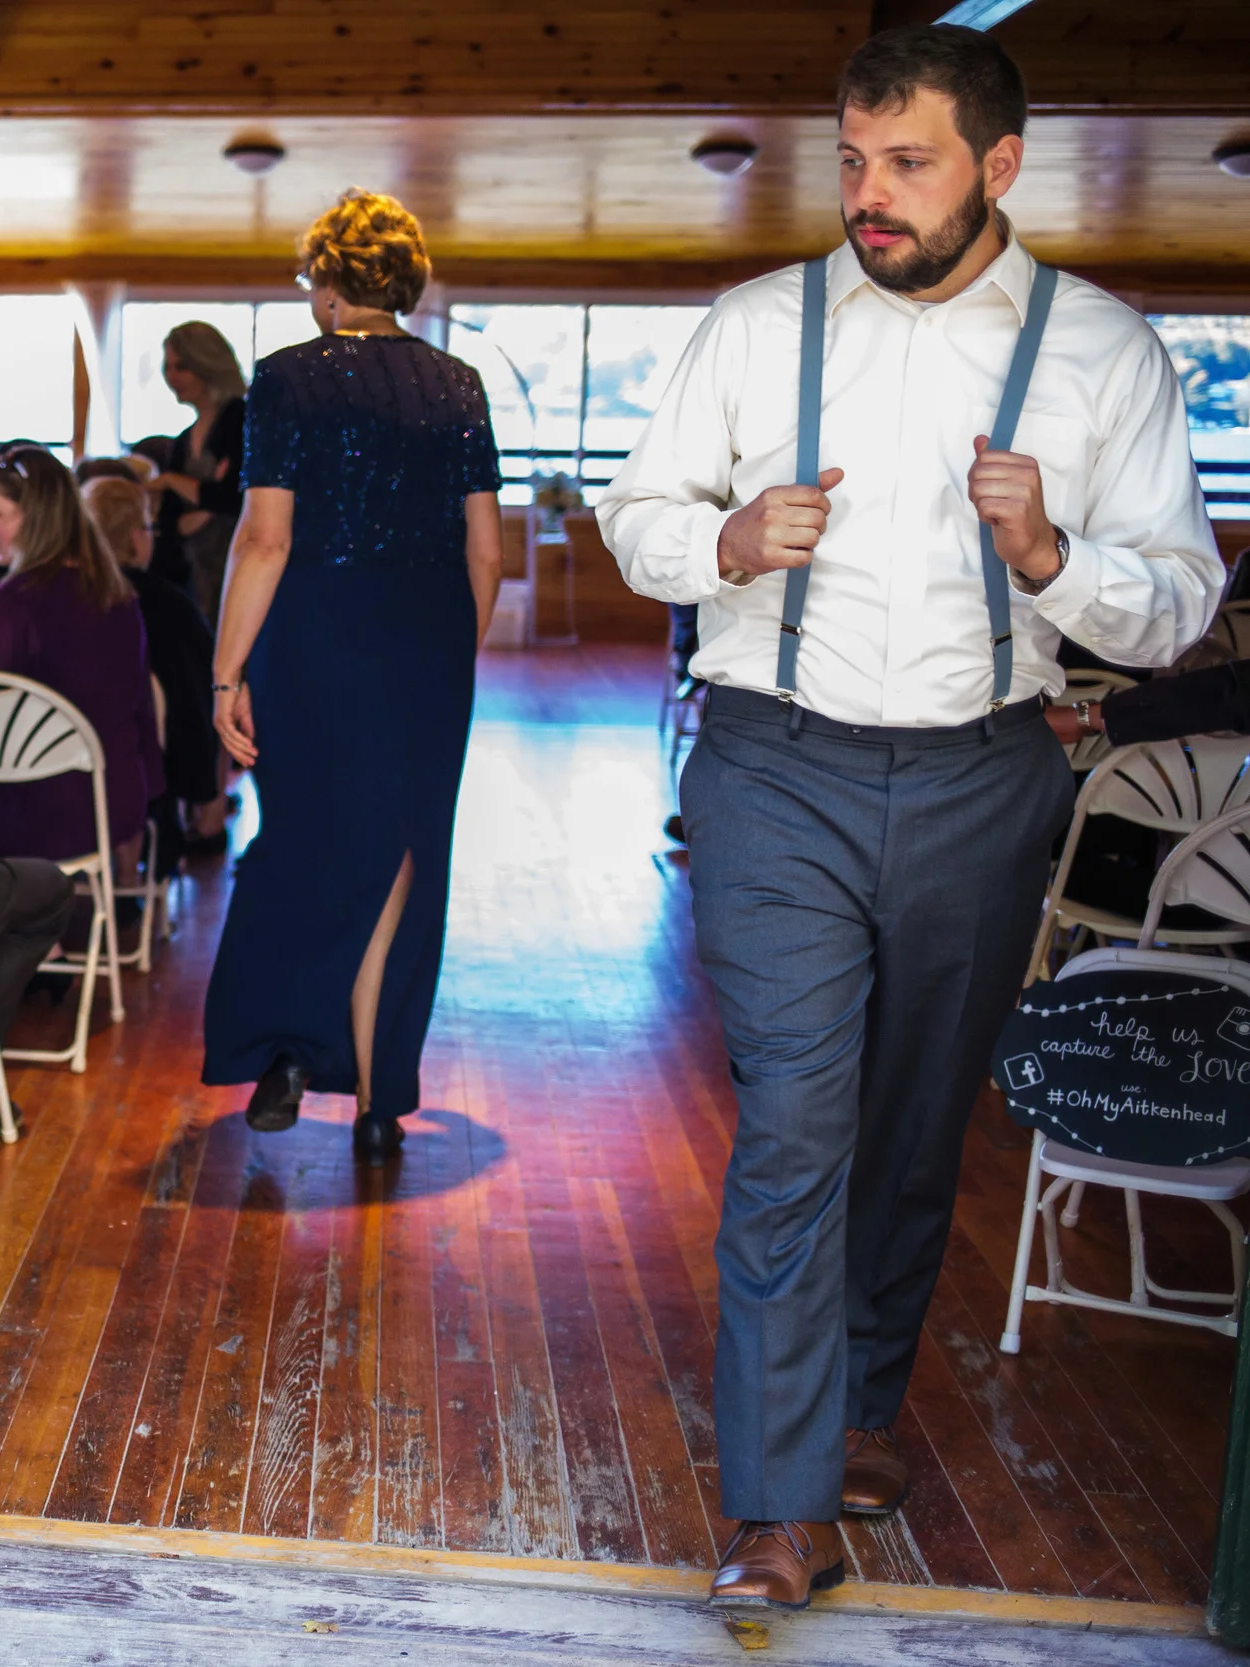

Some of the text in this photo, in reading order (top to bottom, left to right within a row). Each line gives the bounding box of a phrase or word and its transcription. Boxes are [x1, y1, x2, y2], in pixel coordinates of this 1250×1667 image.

[1090, 1010, 1205, 1052] help us
[1040, 1038, 1116, 1061] capture
[1131, 1045, 1172, 1067] the
[1047, 1087, 1227, 1127] #OhMyAitkenhead
